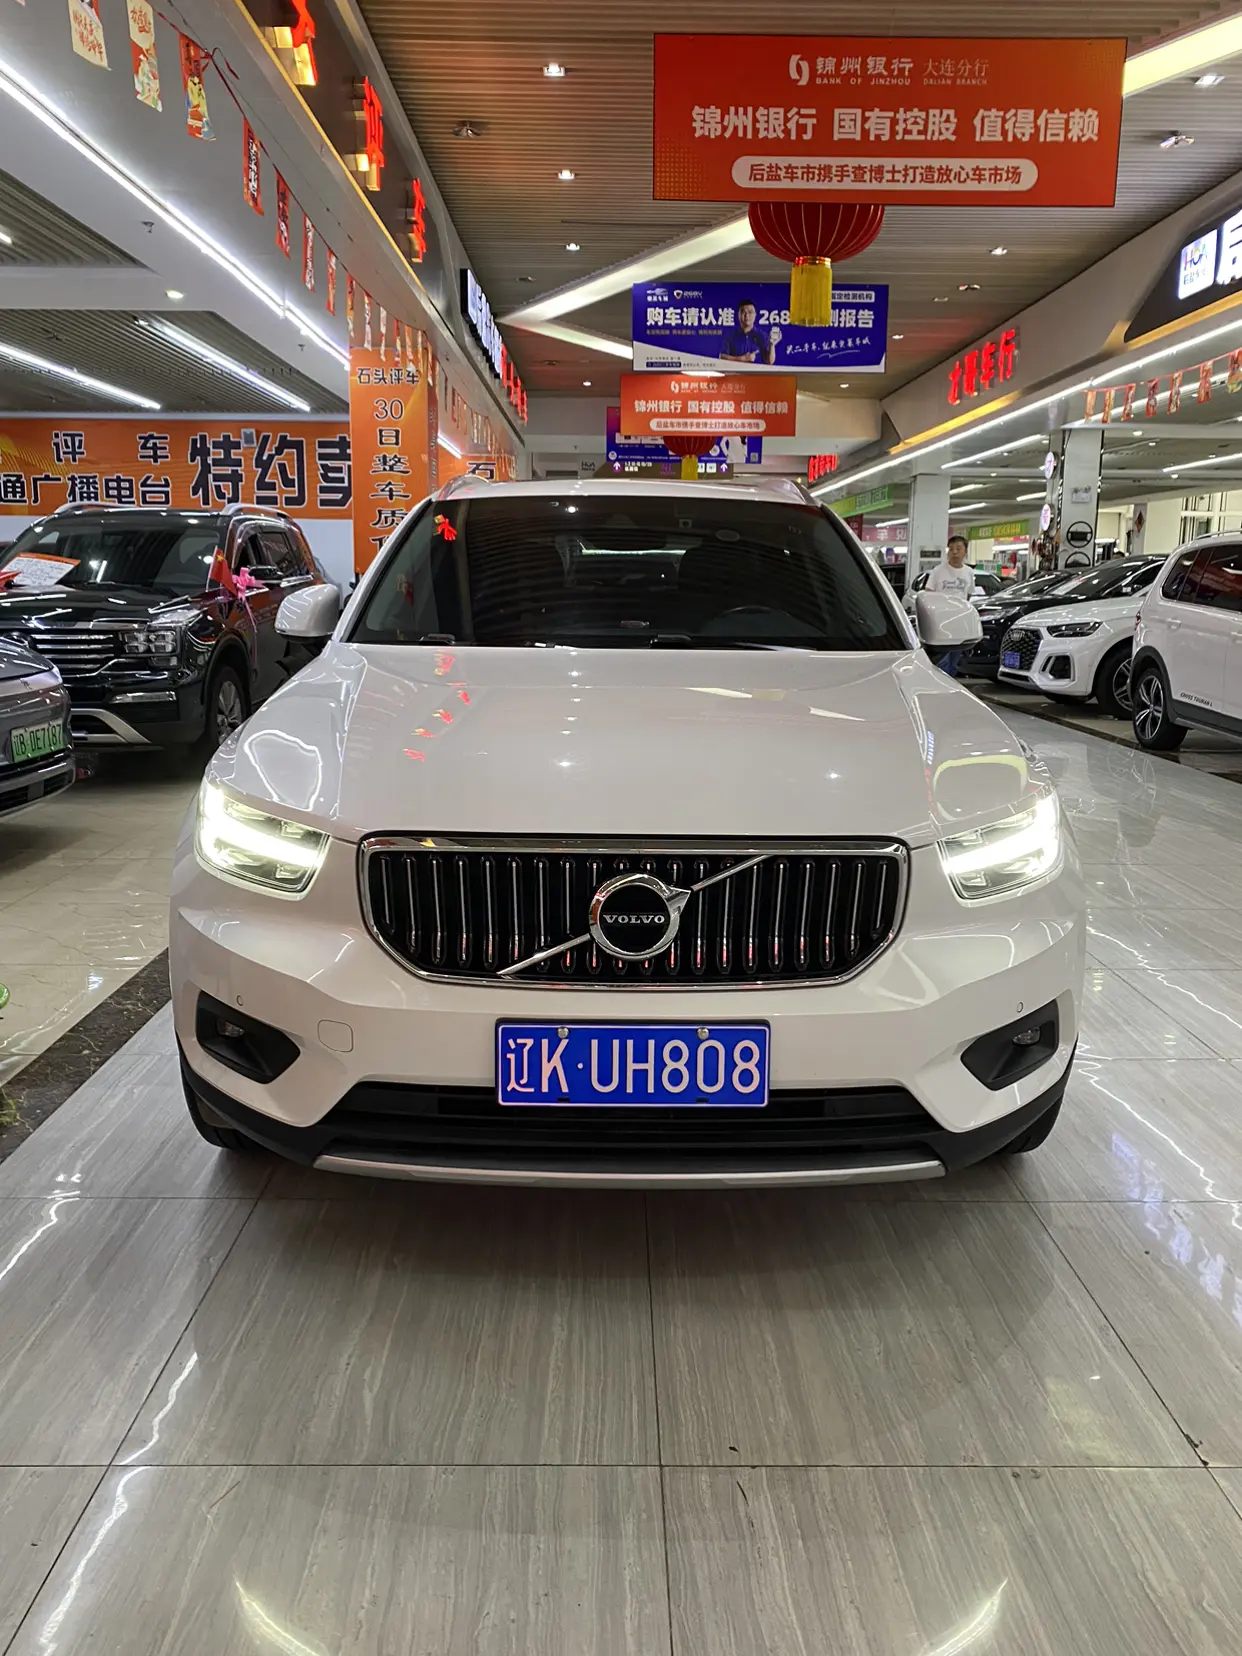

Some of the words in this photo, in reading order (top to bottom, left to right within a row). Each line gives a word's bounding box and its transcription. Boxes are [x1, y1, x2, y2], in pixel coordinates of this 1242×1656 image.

[815, 55, 914, 77] 锦州银行
[923, 57, 989, 77] 大连分行
[815, 77, 842, 85] BANK
[870, 78, 911, 86] JINZHOU
[923, 78, 952, 86] DALIAN
[956, 78, 988, 86] BRANCH
[691, 105, 817, 141] 锦州银行
[832, 107, 958, 142] 国有控股
[972, 107, 1099, 144] 值得信赖
[748, 163, 1023, 185] 后盐车市携手查博士打造放心车市场
[646, 307, 735, 326] 购车请认准
[357, 367, 420, 385] 石头评车
[634, 400, 682, 413] 锦州银行
[687, 400, 735, 414] 国有控股
[740, 401, 788, 414] 值得信赖
[602, 914, 665, 924] VOLVO
